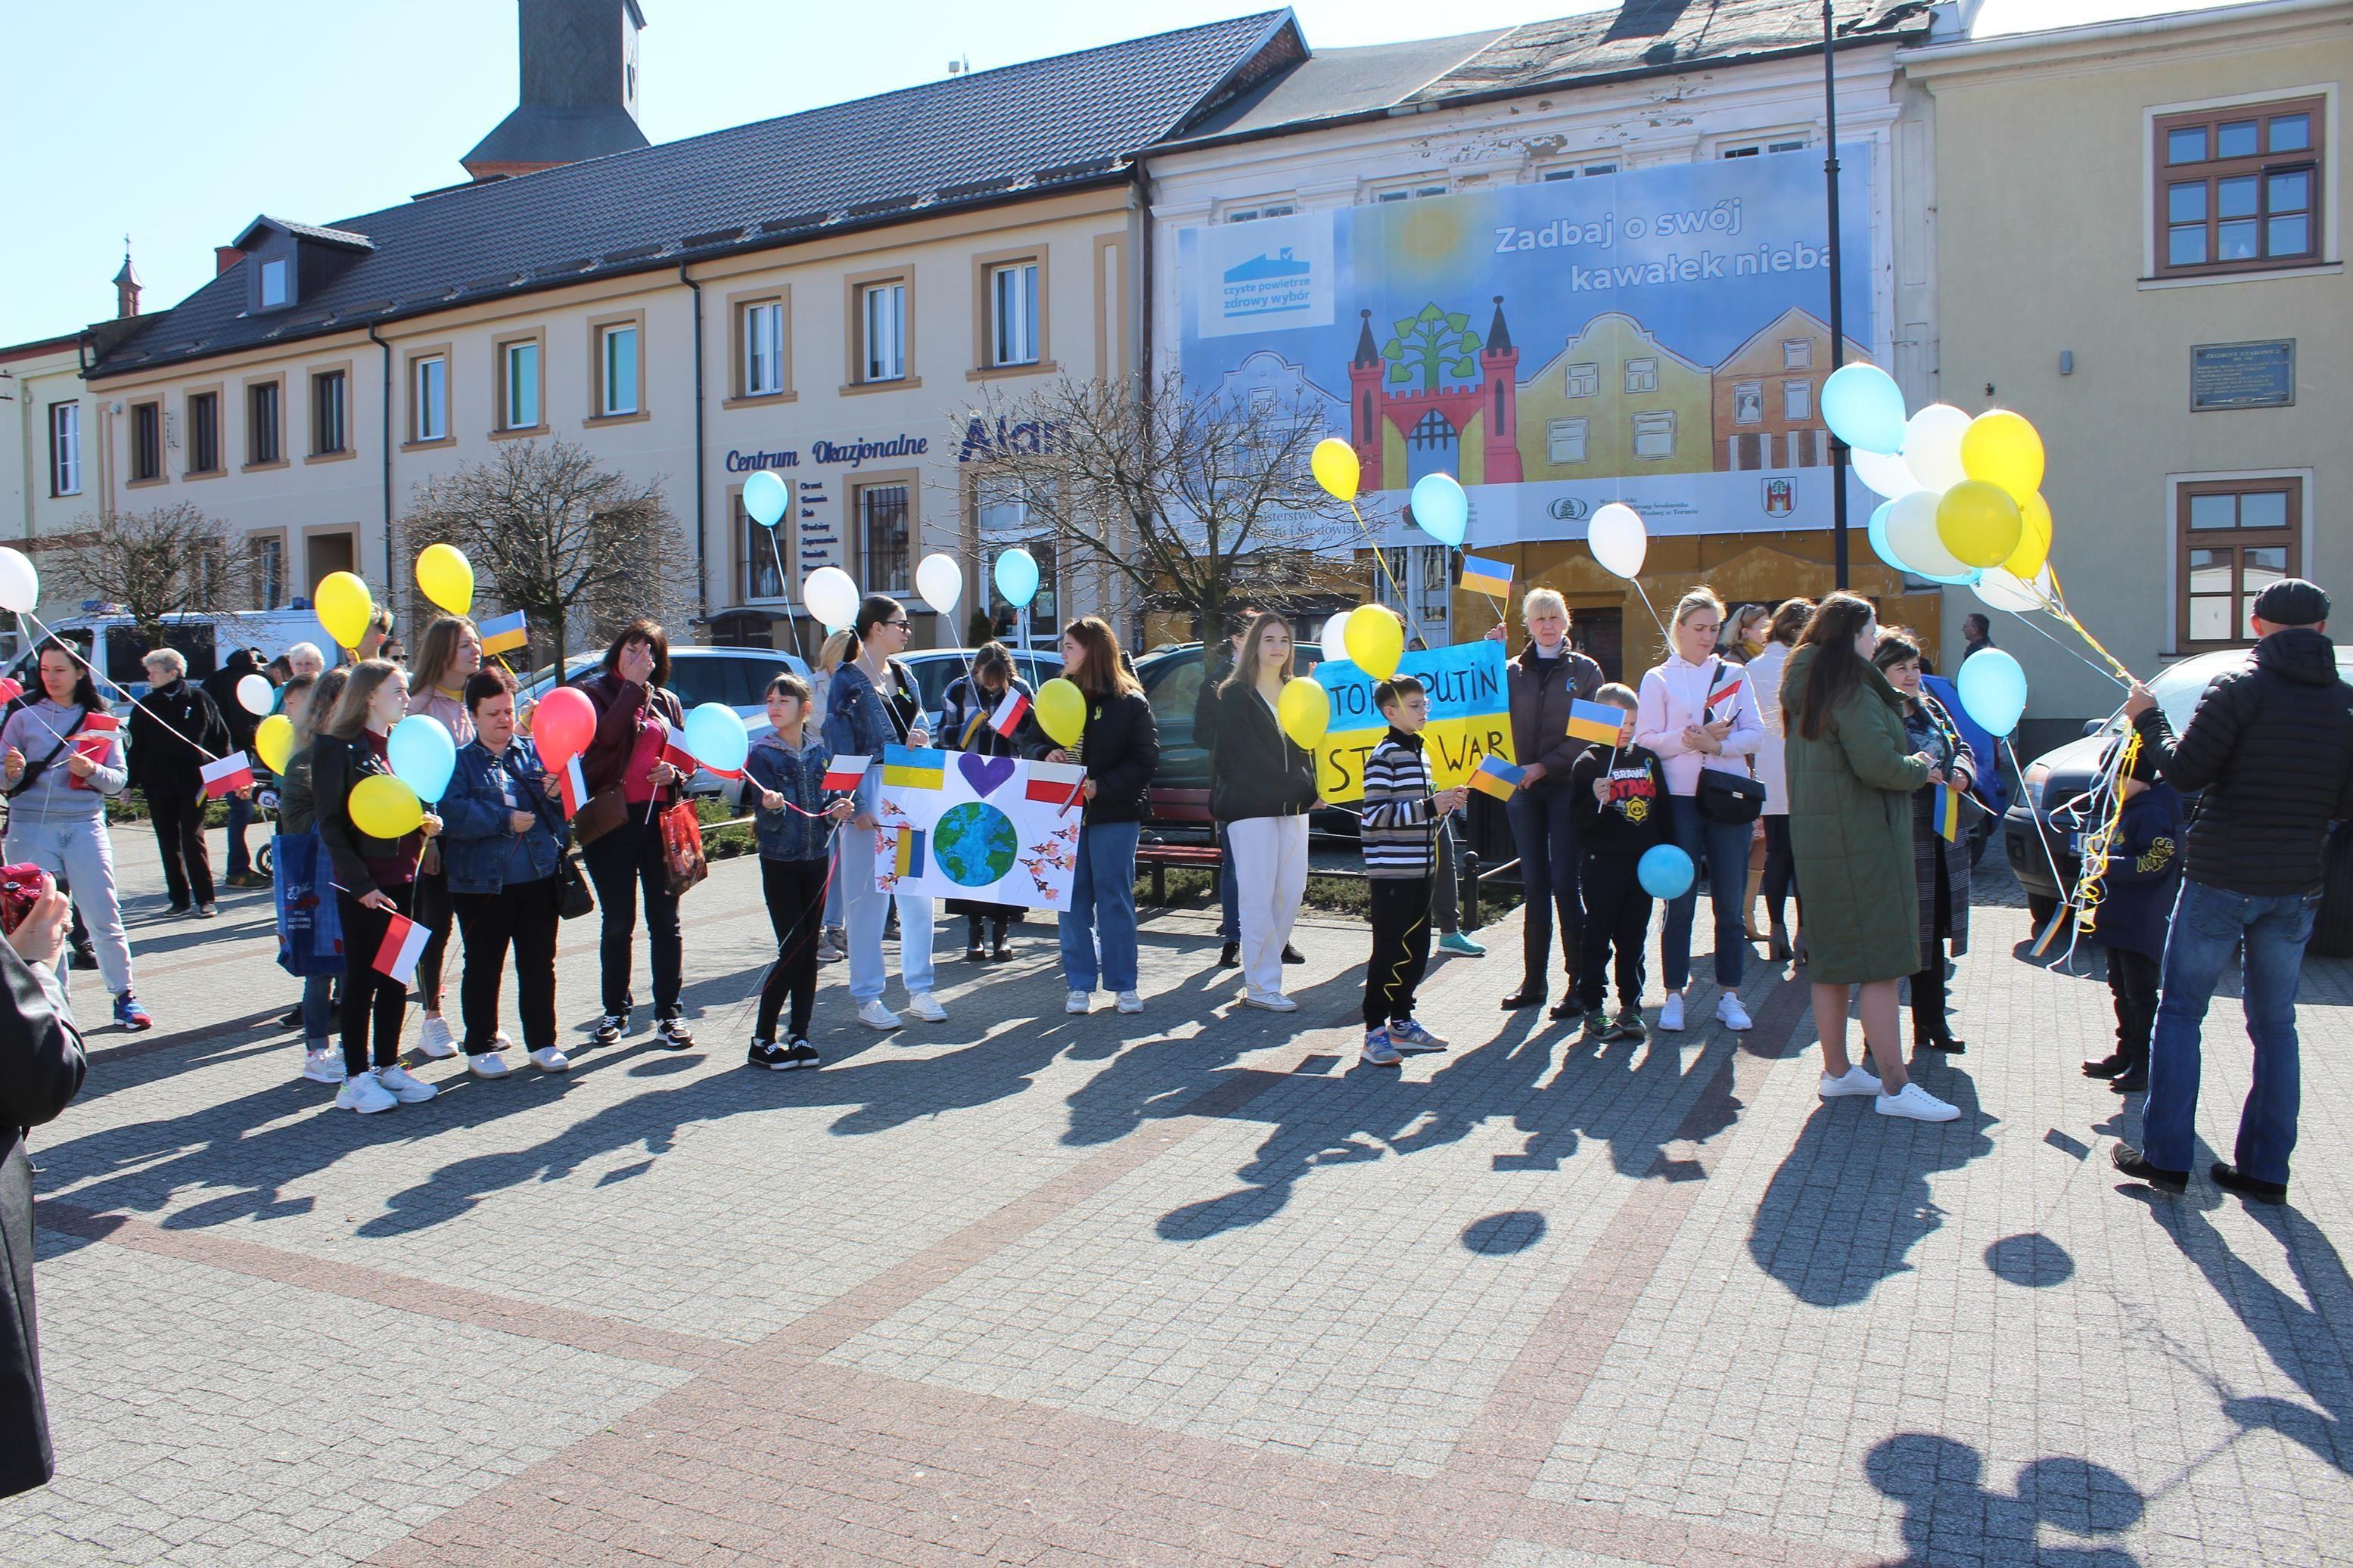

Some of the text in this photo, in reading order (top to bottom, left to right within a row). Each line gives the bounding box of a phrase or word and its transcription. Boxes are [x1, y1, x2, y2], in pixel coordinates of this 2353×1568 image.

[1494, 197, 1742, 254] Zadbaj o swój
[1223, 278, 1311, 296] czyste powietrze
[1571, 241, 1832, 293] kawałek nieba
[1223, 288, 1311, 309] zdrowy wybór
[726, 433, 928, 473] Centrum Okazjonalne
[1438, 730, 1509, 772] WAR
